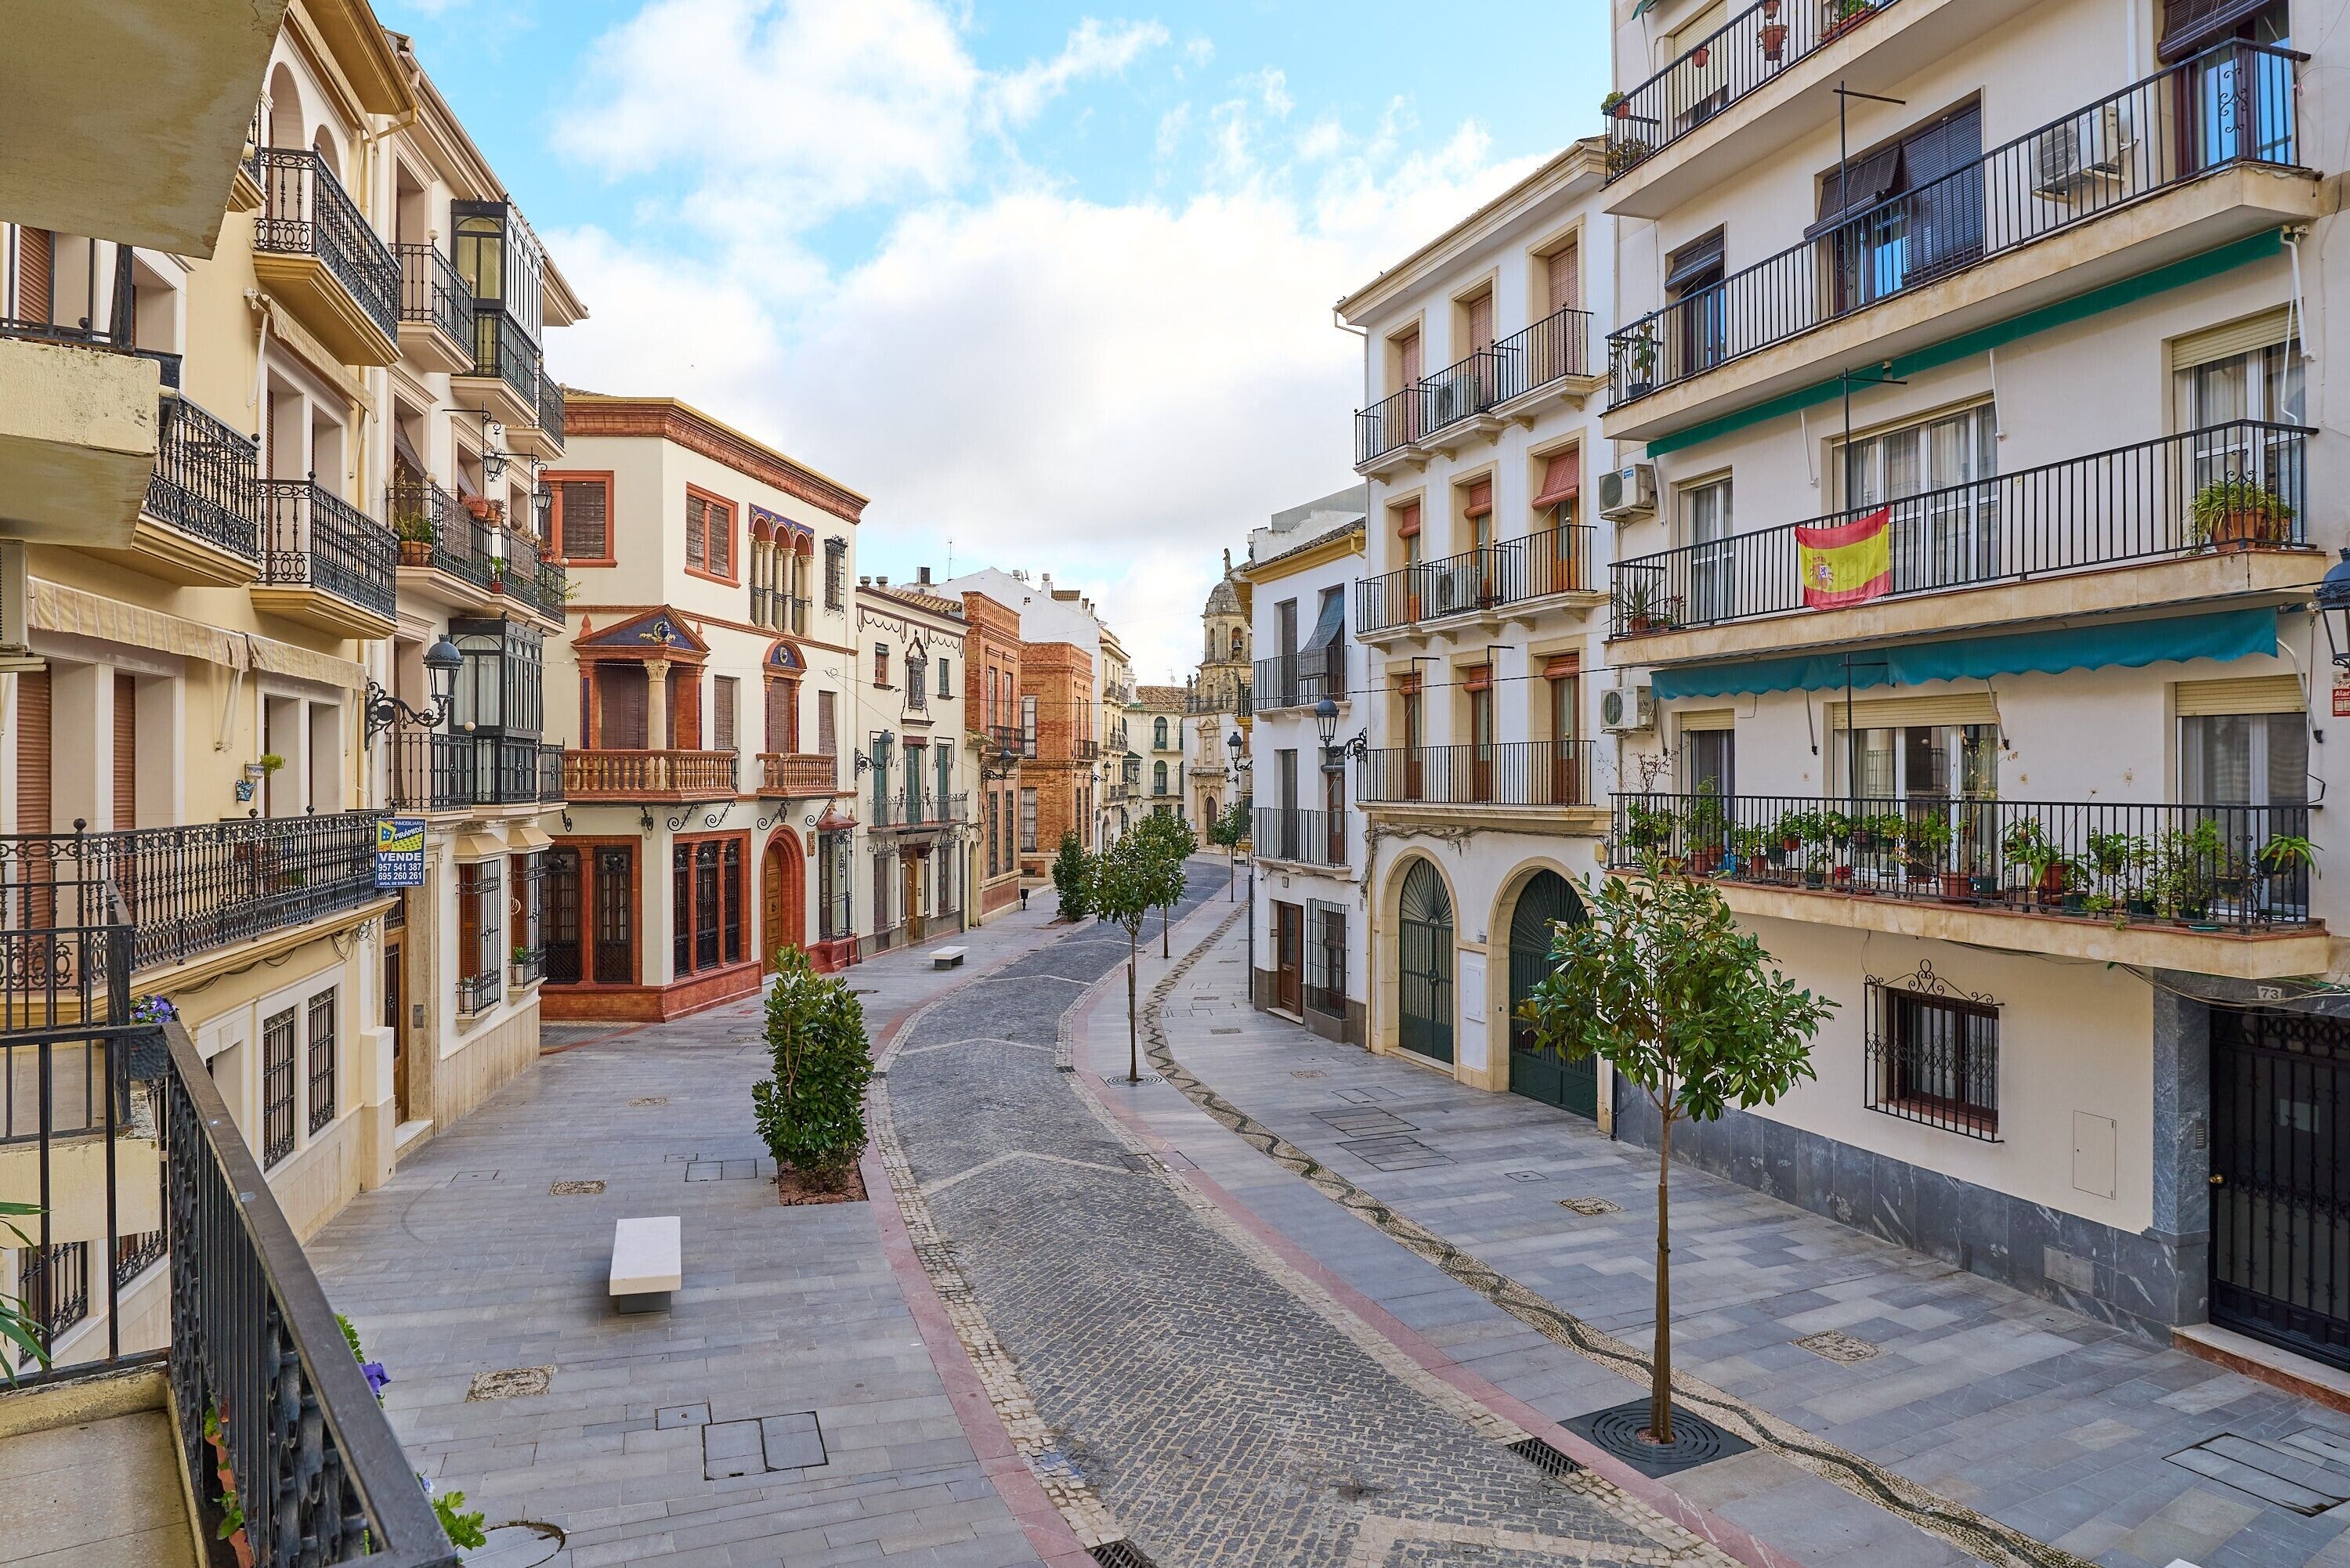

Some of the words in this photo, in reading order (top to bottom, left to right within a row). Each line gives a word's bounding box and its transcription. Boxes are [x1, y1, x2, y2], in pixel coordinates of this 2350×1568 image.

[394, 826, 424, 840] PIRÁMIDE
[379, 852, 421, 862] VENDE
[2261, 988, 2279, 999] 73
